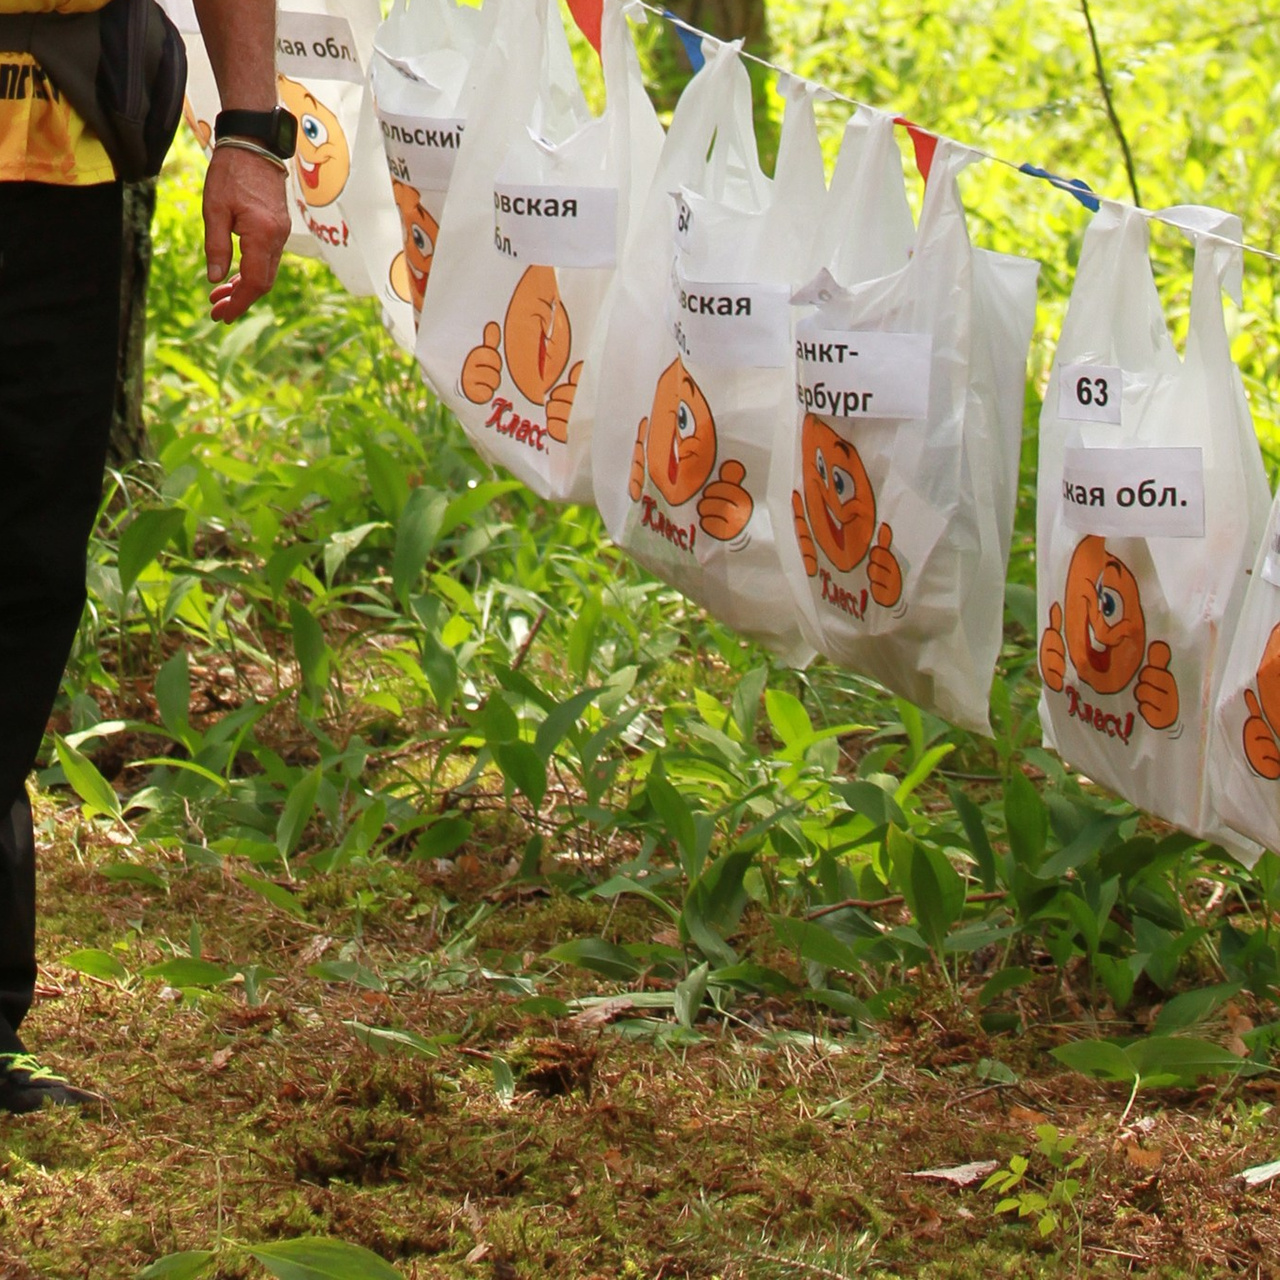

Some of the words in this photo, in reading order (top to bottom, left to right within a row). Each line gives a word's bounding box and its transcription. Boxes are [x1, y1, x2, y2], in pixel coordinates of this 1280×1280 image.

[314, 36, 357, 62] обл.
[1076, 377, 1108, 406] 63
[485, 397, 550, 455] Класс
[1116, 479, 1188, 507] обл.
[641, 495, 696, 554] Класс!
[1065, 685, 1135, 746] Класс!
